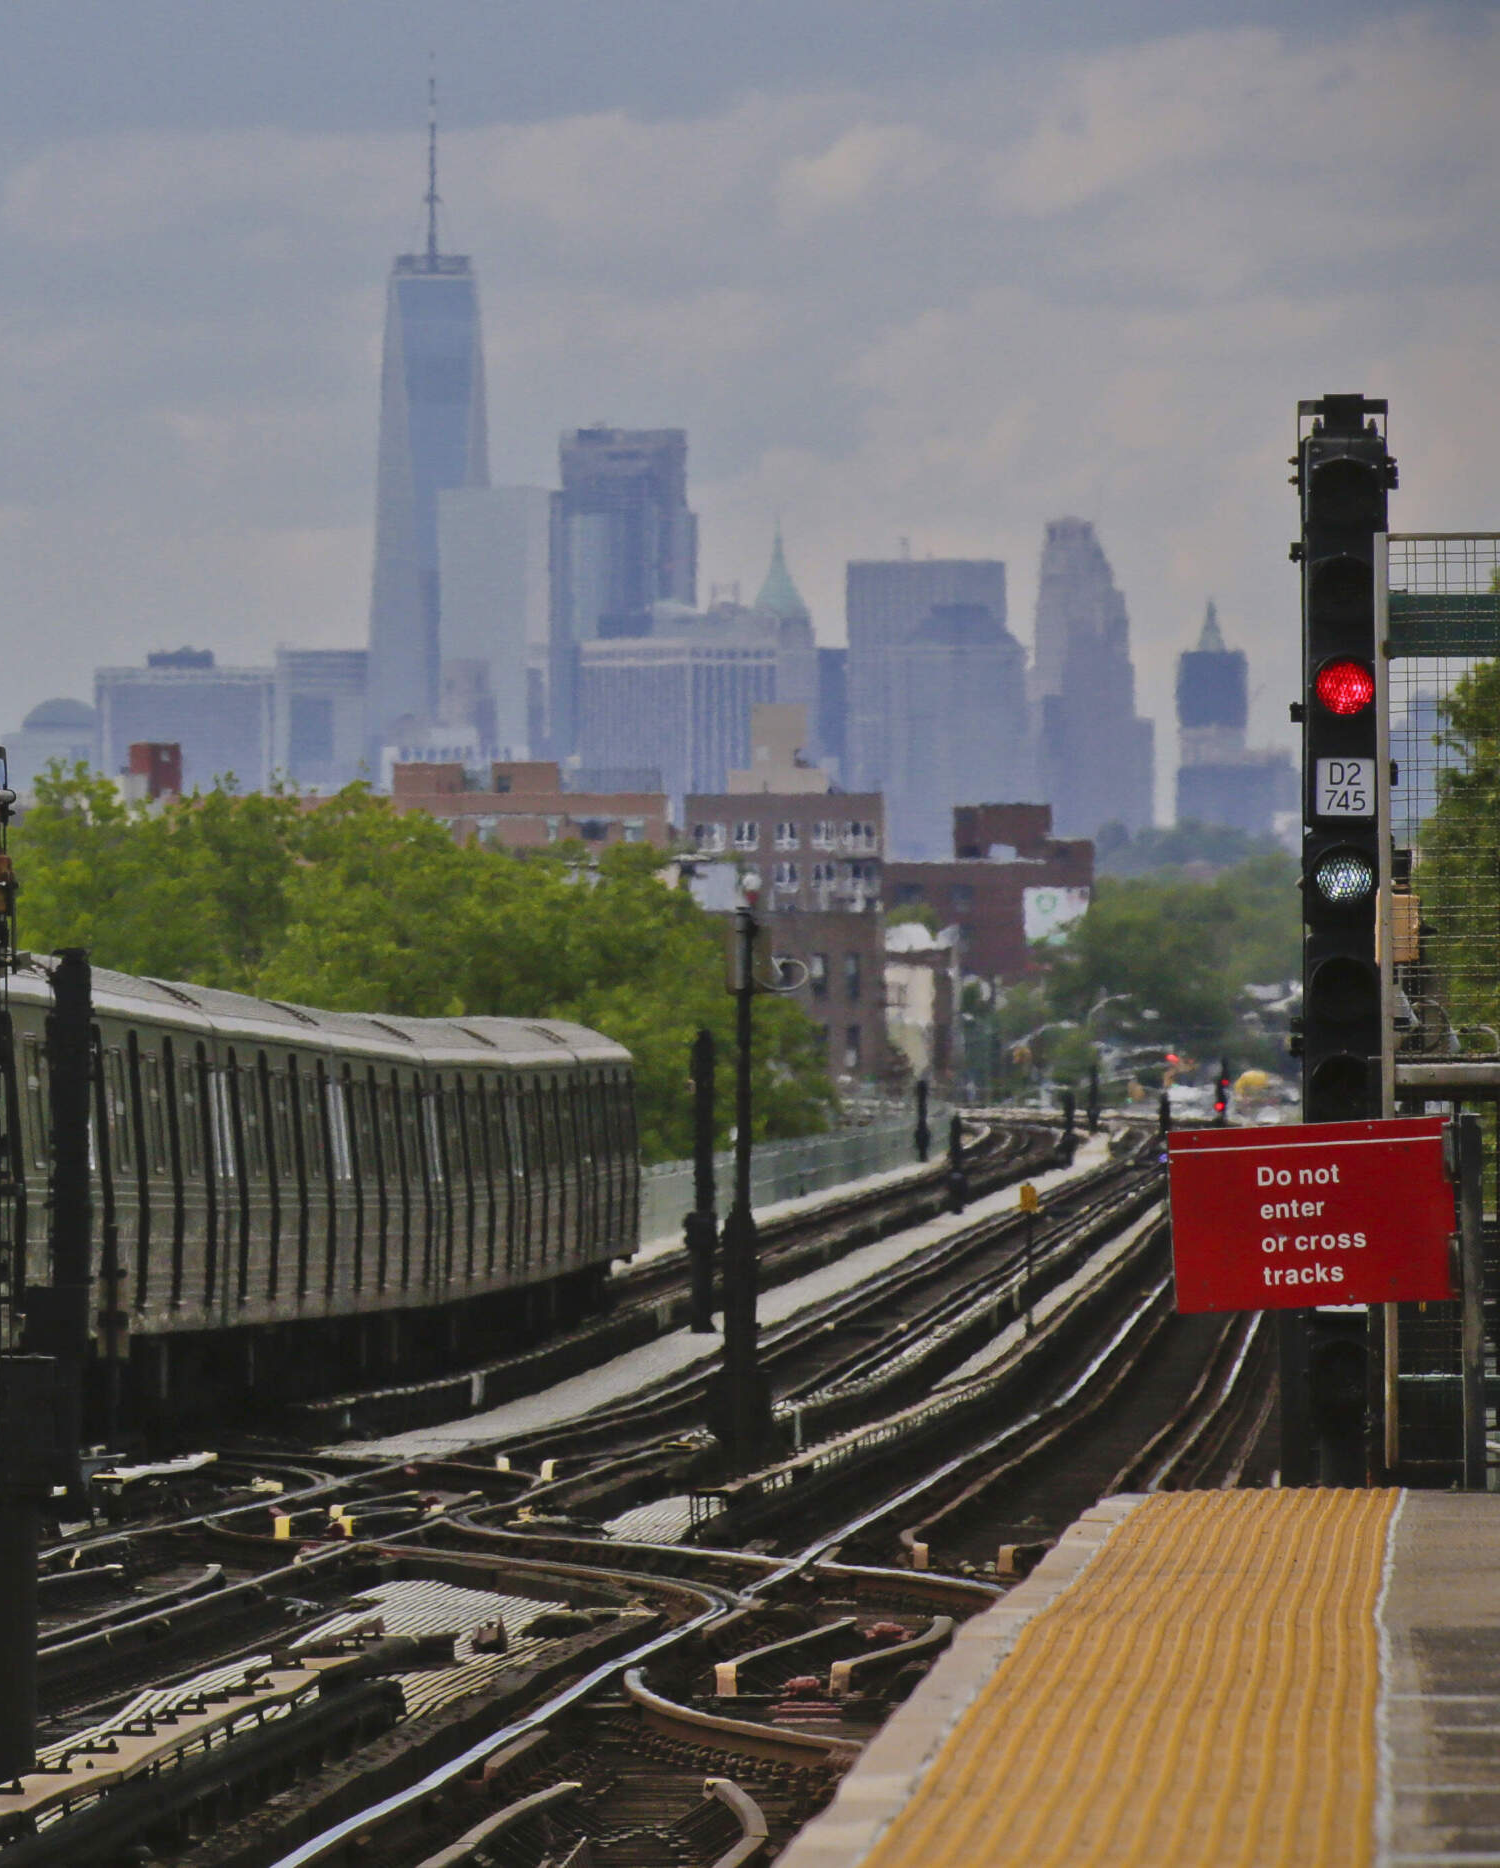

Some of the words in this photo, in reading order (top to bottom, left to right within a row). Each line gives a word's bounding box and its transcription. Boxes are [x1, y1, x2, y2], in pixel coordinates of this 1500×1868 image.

[1329, 762, 1361, 785] D2
[1325, 789, 1366, 811] 745
[1257, 1166, 1292, 1187] Do
[1299, 1164, 1340, 1185] not
[1260, 1199, 1325, 1219] enter
[1261, 1236, 1288, 1253] or
[1294, 1232, 1367, 1251] cross
[1263, 1262, 1344, 1286] tracks
